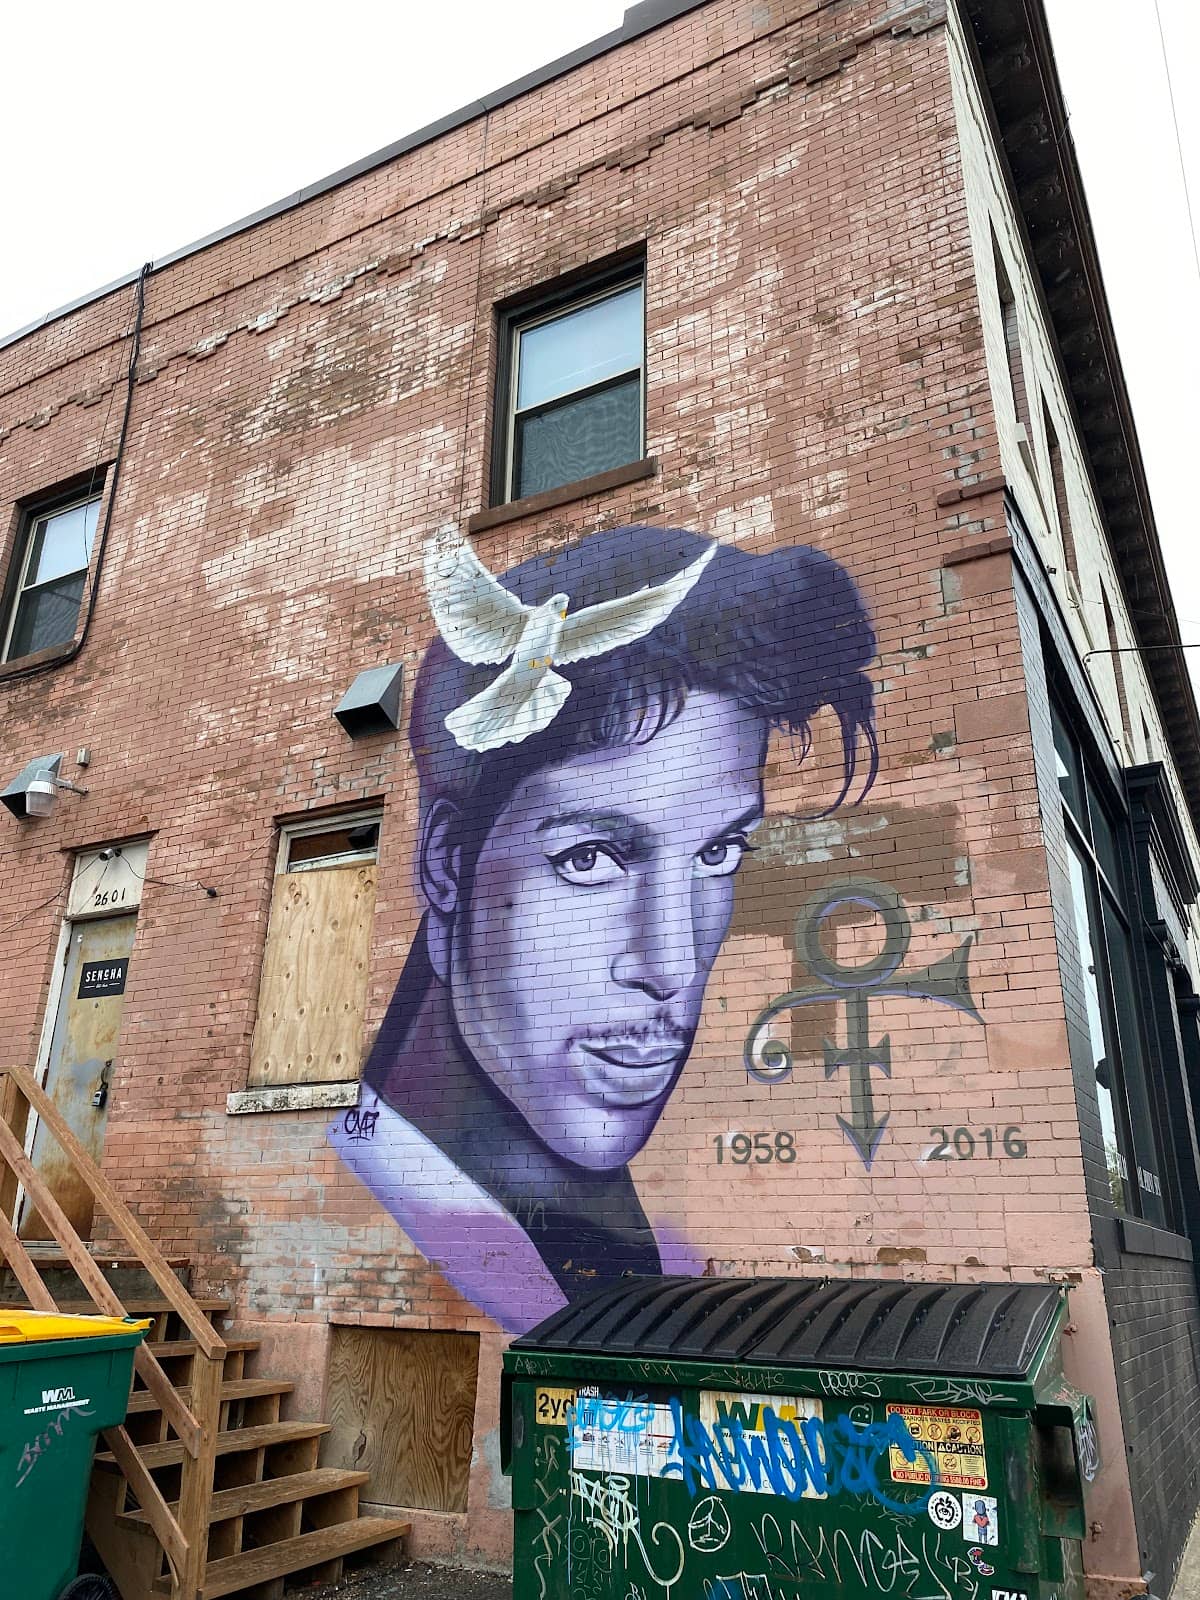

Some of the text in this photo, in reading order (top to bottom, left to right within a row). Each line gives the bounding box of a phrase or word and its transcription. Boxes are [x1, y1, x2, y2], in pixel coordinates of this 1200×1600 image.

[94, 888, 126, 907] 2601
[85, 967, 122, 983] SENCHA
[712, 1131, 797, 1164] 1958
[926, 1126, 1027, 1161] 2016
[903, 1407, 917, 1416] NOT
[918, 1408, 937, 1417] PARK
[939, 1409, 950, 1418] OR
[951, 1410, 977, 1419] BLOCK
[945, 1443, 982, 1454] CAUTION
